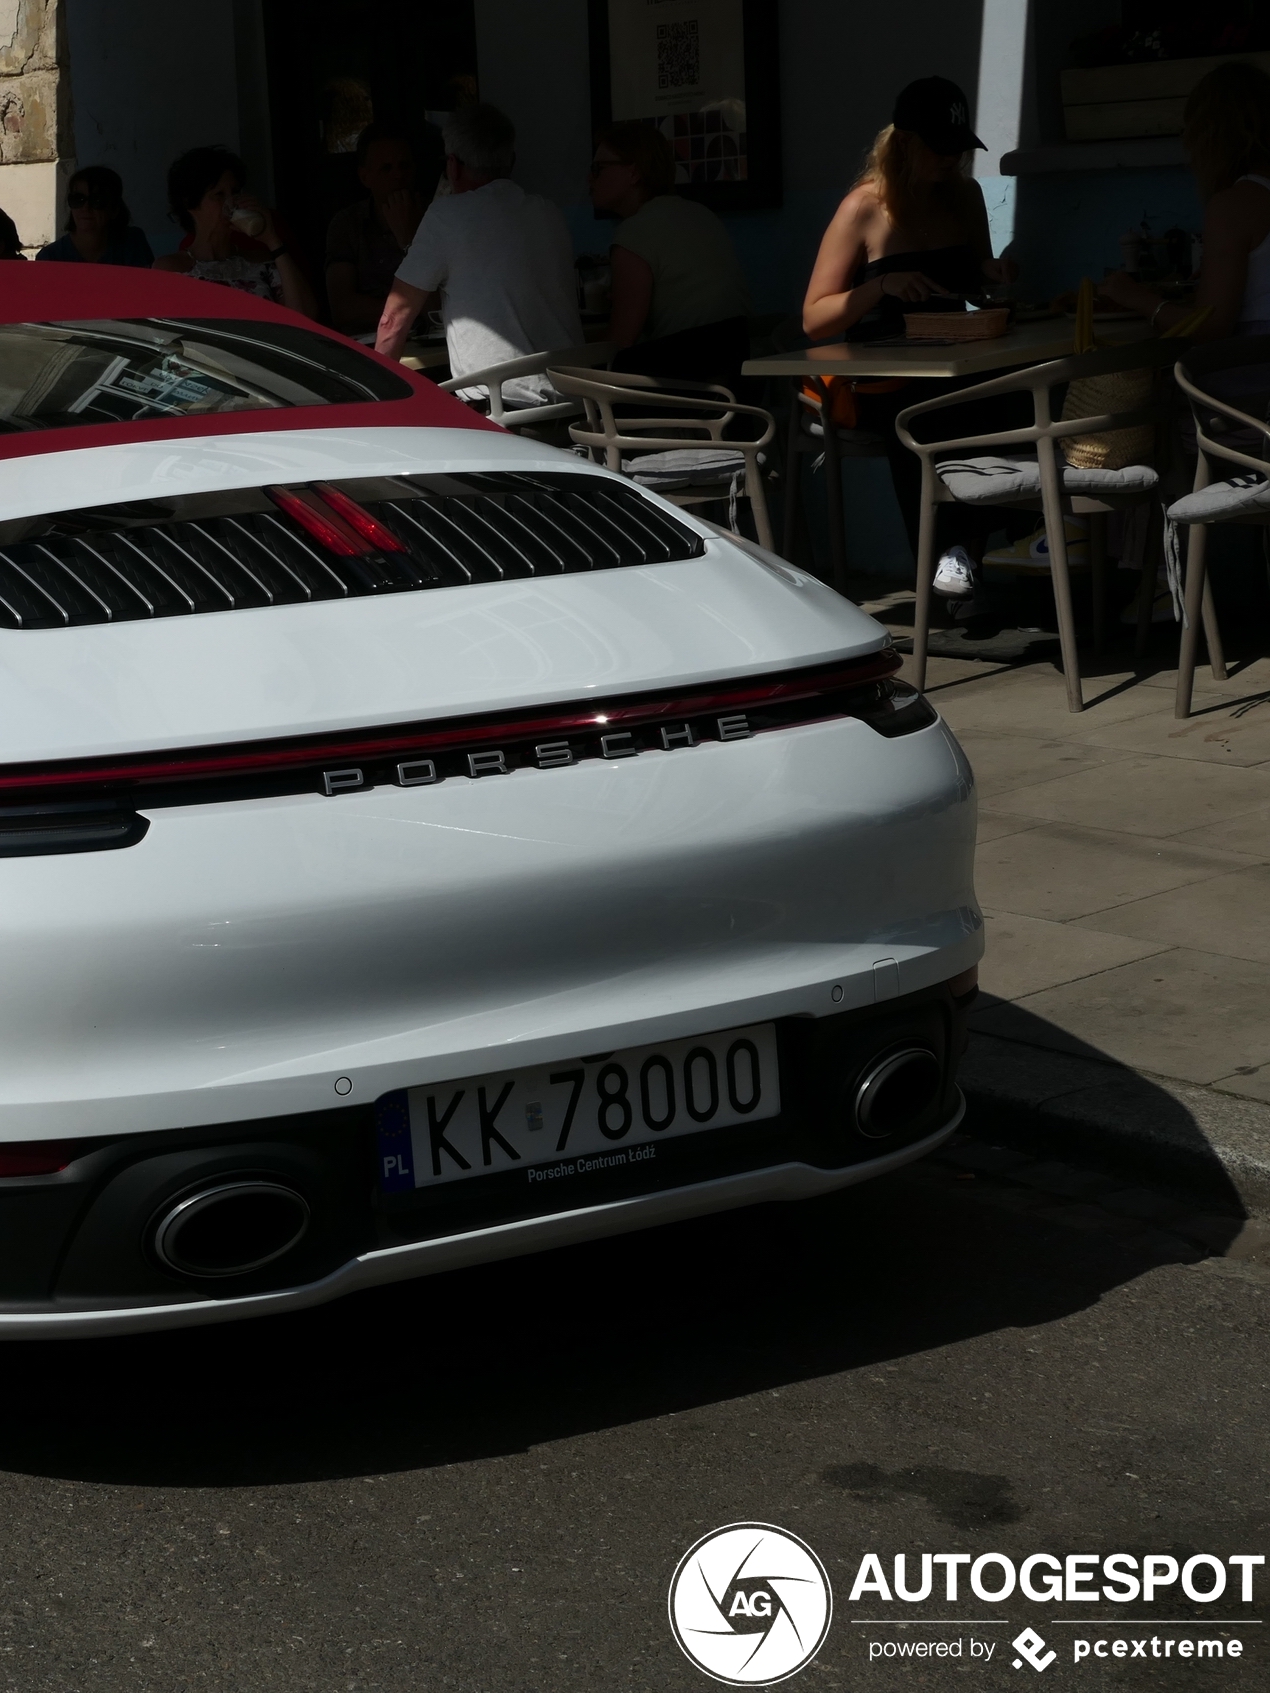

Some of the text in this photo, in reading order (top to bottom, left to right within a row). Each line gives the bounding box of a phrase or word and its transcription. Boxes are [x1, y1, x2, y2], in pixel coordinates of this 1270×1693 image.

[322, 713, 751, 796] PORSCHE
[426, 1037, 762, 1177] KK 78000
[382, 1155, 410, 1178] PL
[527, 1143, 657, 1183] Porsche Centrum Łódź
